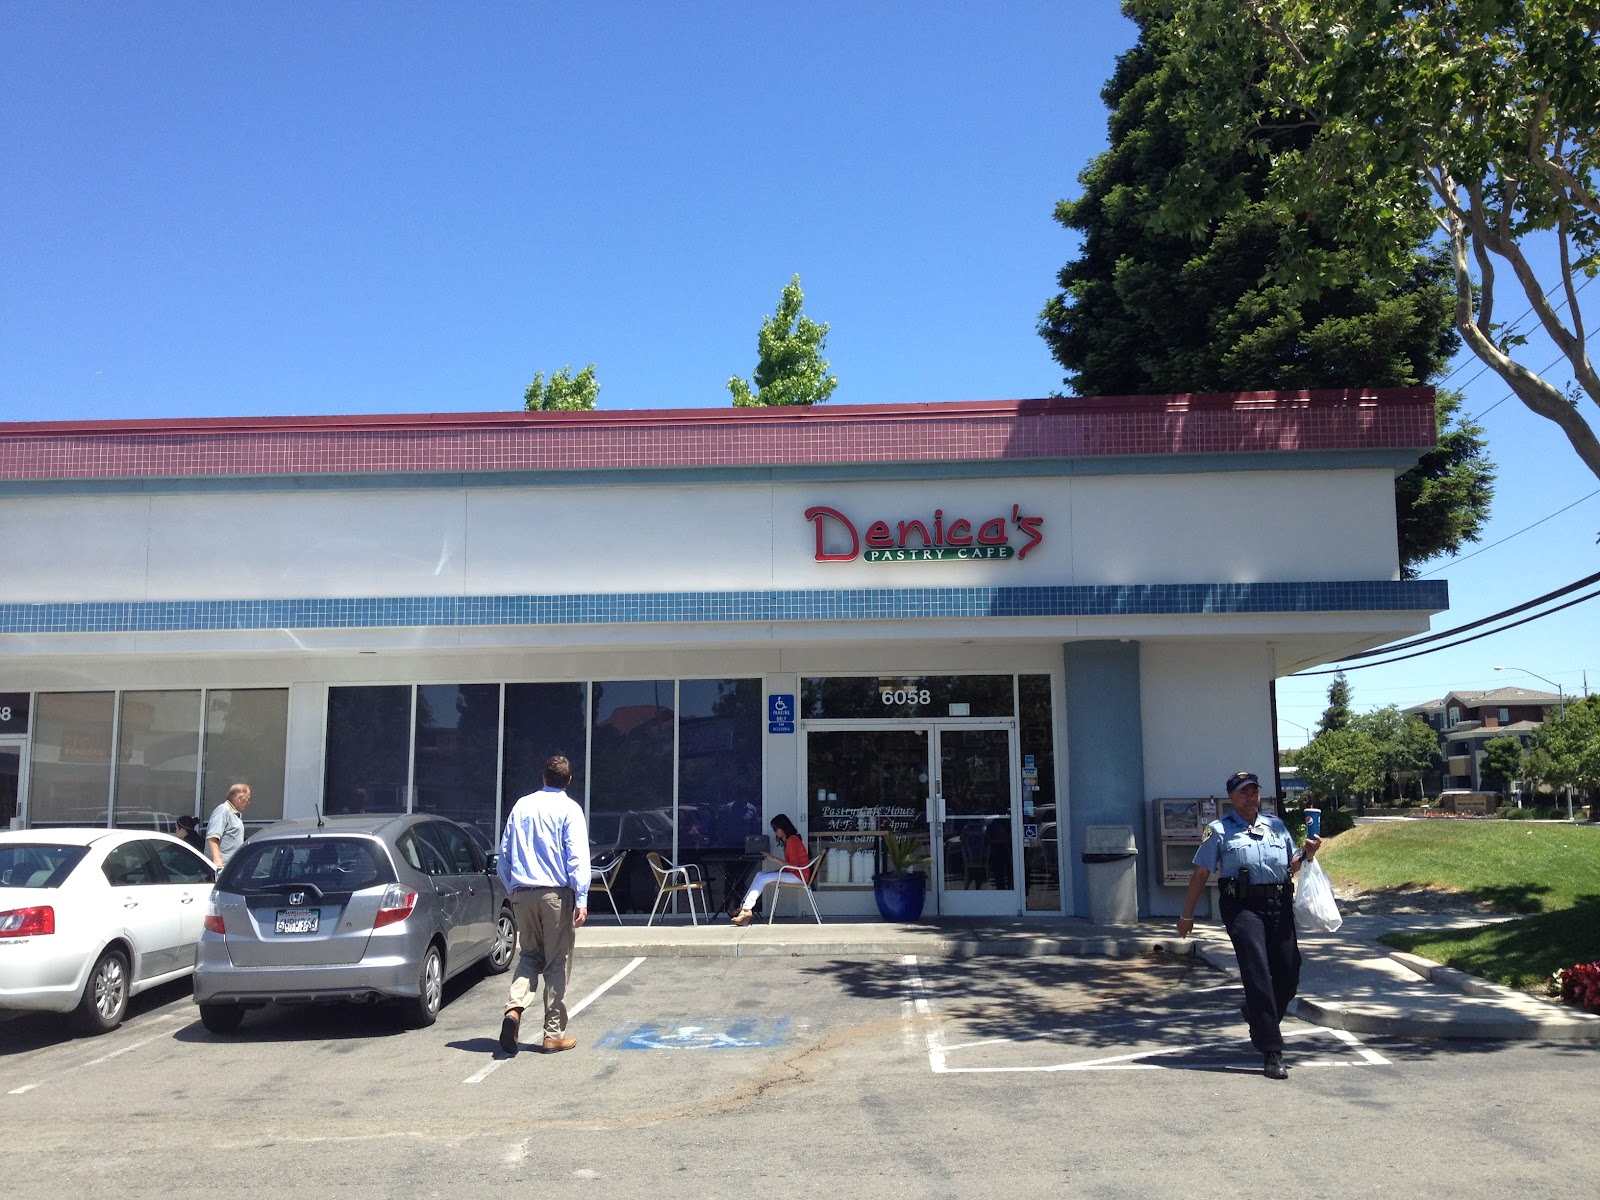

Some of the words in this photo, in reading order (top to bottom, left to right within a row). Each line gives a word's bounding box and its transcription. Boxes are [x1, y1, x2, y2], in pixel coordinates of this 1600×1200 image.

[804, 504, 1043, 562] Denica's
[871, 550, 945, 561] PASTRY
[958, 547, 1007, 558] CAFE
[881, 689, 931, 705] 6058
[0, 706, 11, 721] 8
[822, 806, 857, 819] Pastry
[885, 804, 916, 815] Hours
[888, 819, 910, 832] 4pm
[830, 834, 850, 844] Sat:
